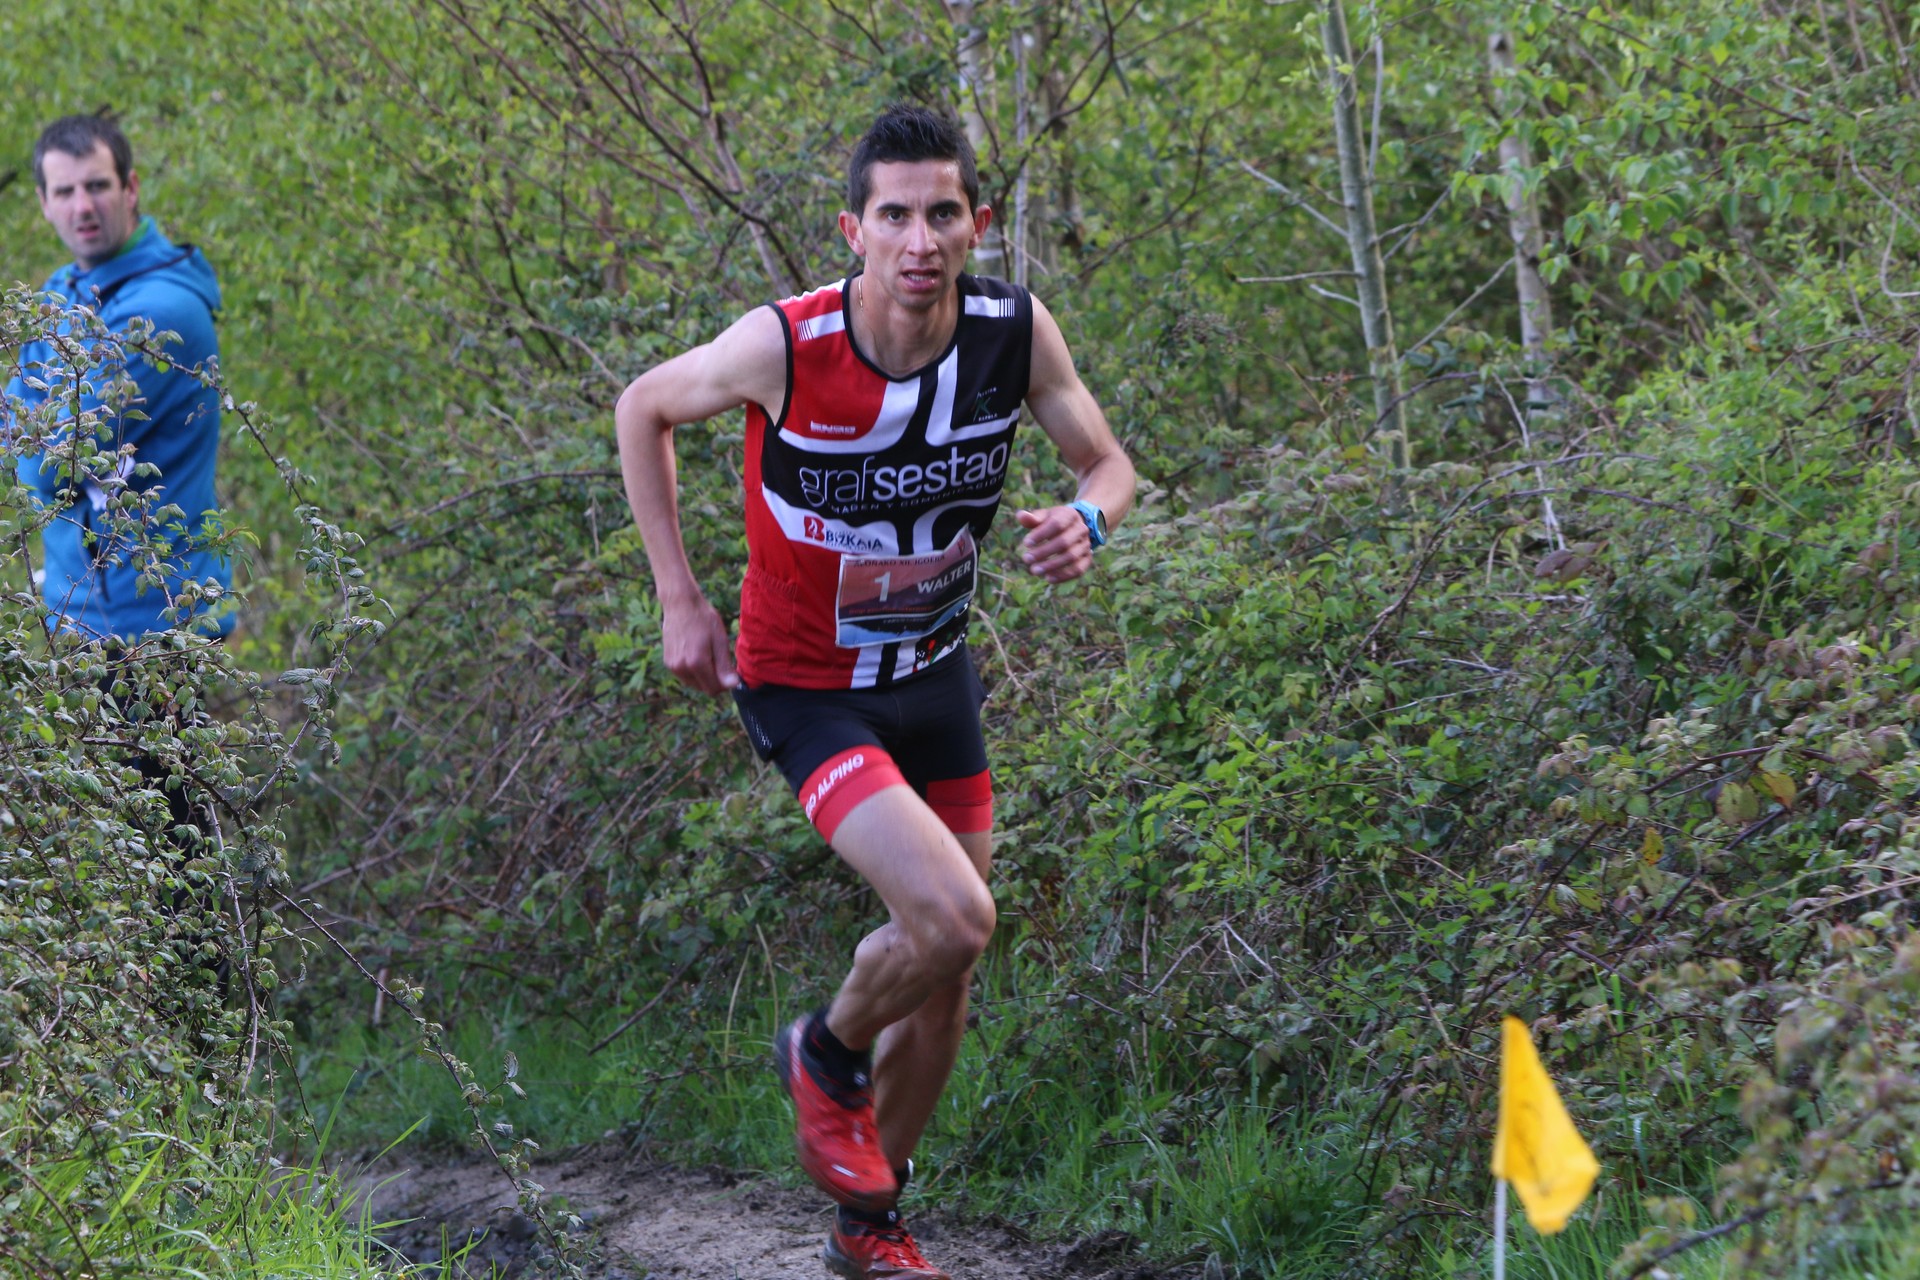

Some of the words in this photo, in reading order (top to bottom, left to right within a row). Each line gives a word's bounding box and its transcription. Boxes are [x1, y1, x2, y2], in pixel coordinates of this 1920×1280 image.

[799, 442, 1008, 508] grafsestao
[874, 571, 892, 602] 1
[917, 560, 972, 594] WALTER
[818, 753, 864, 801] ALPINO
